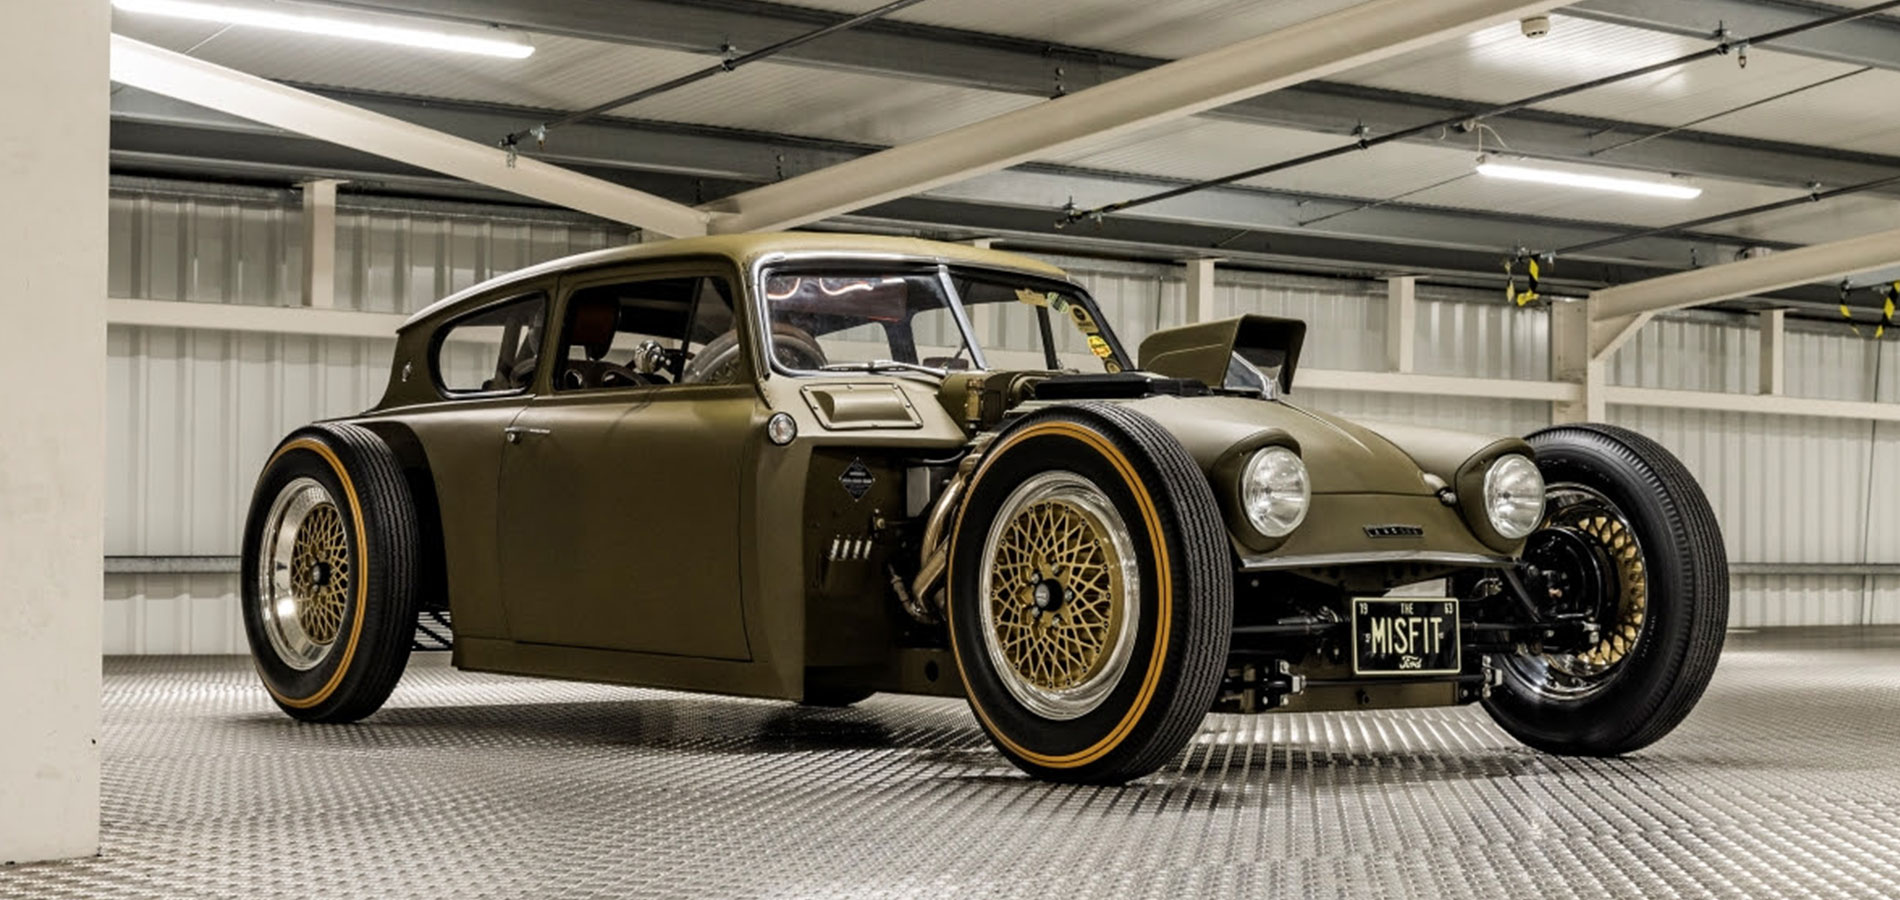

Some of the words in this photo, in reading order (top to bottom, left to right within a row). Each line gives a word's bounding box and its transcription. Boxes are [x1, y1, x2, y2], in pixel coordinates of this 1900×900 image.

[1400, 602, 1414, 615] THE
[1371, 617, 1442, 654] MISFIT
[1399, 655, 1422, 669] Ford
